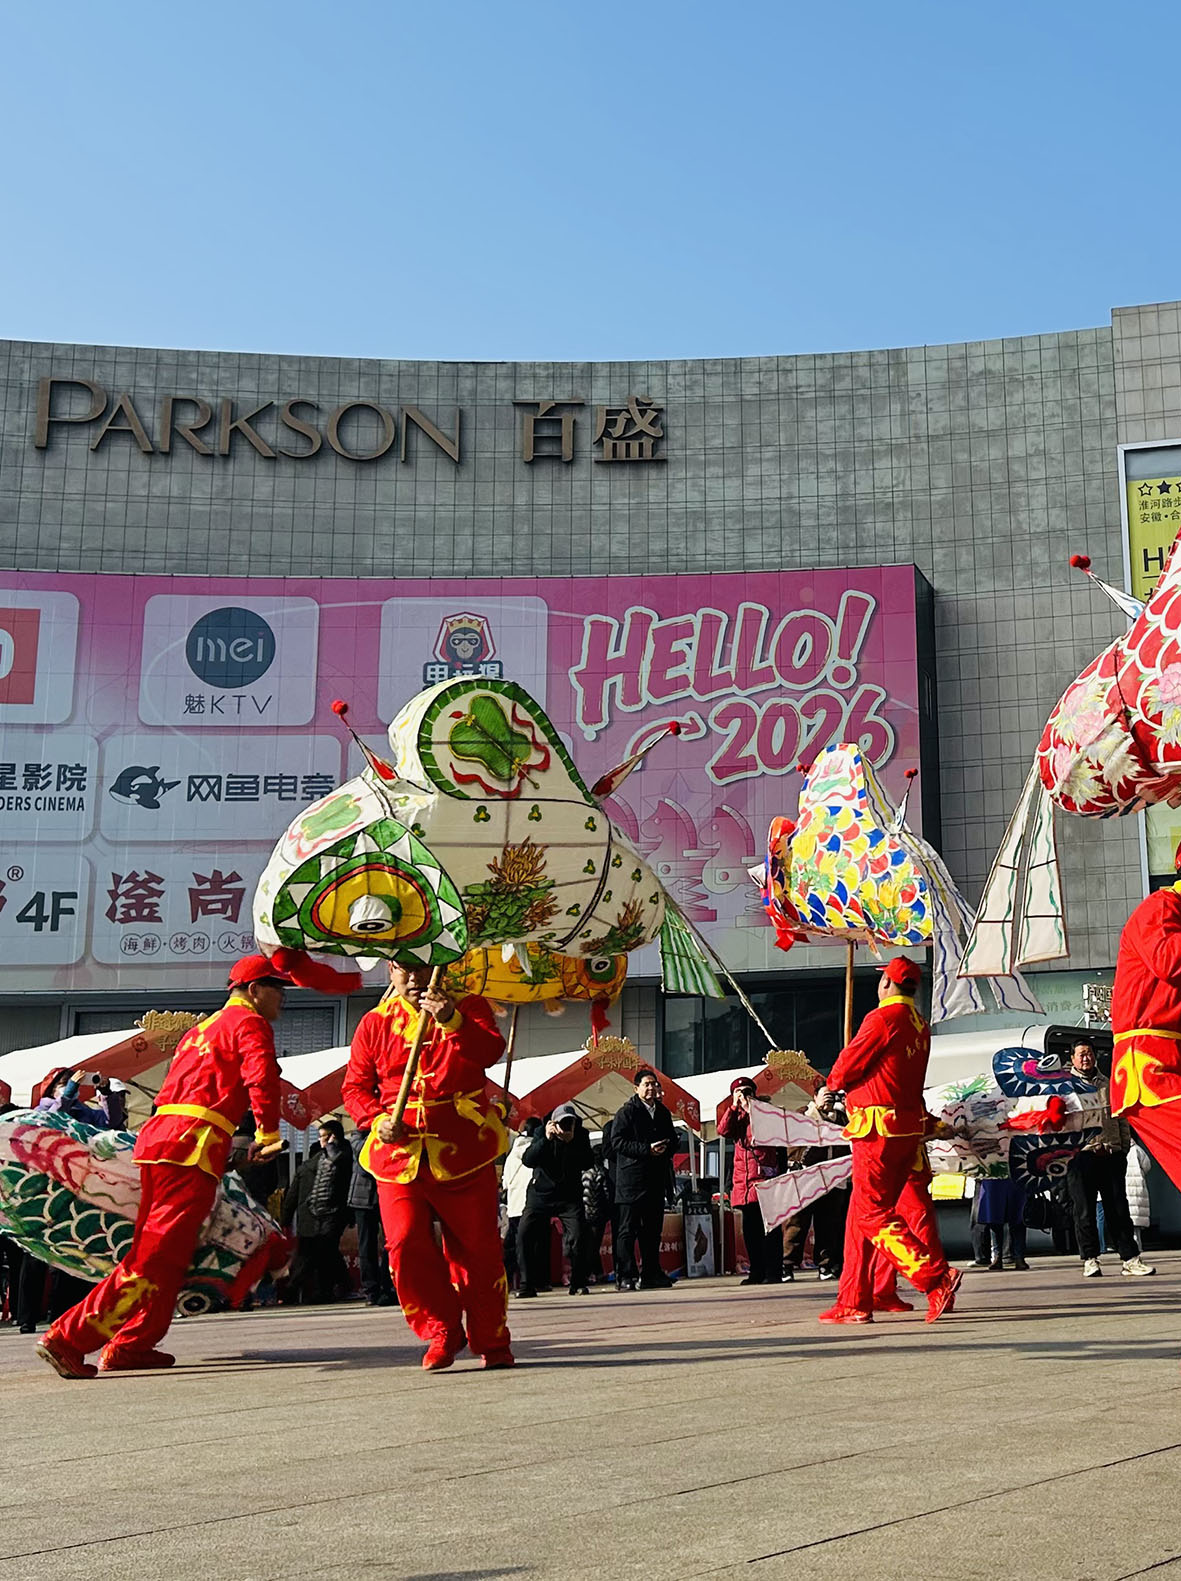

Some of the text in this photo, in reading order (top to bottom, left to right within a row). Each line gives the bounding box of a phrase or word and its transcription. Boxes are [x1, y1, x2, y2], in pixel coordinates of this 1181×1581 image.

[34, 376, 462, 464] PARKSON
[511, 395, 668, 463] 百盛
[196, 632, 264, 662] mei
[571, 592, 875, 735] HELLO!
[707, 685, 893, 783] 2026
[34, 796, 85, 811] CINEMA
[16, 891, 78, 932] 4F
